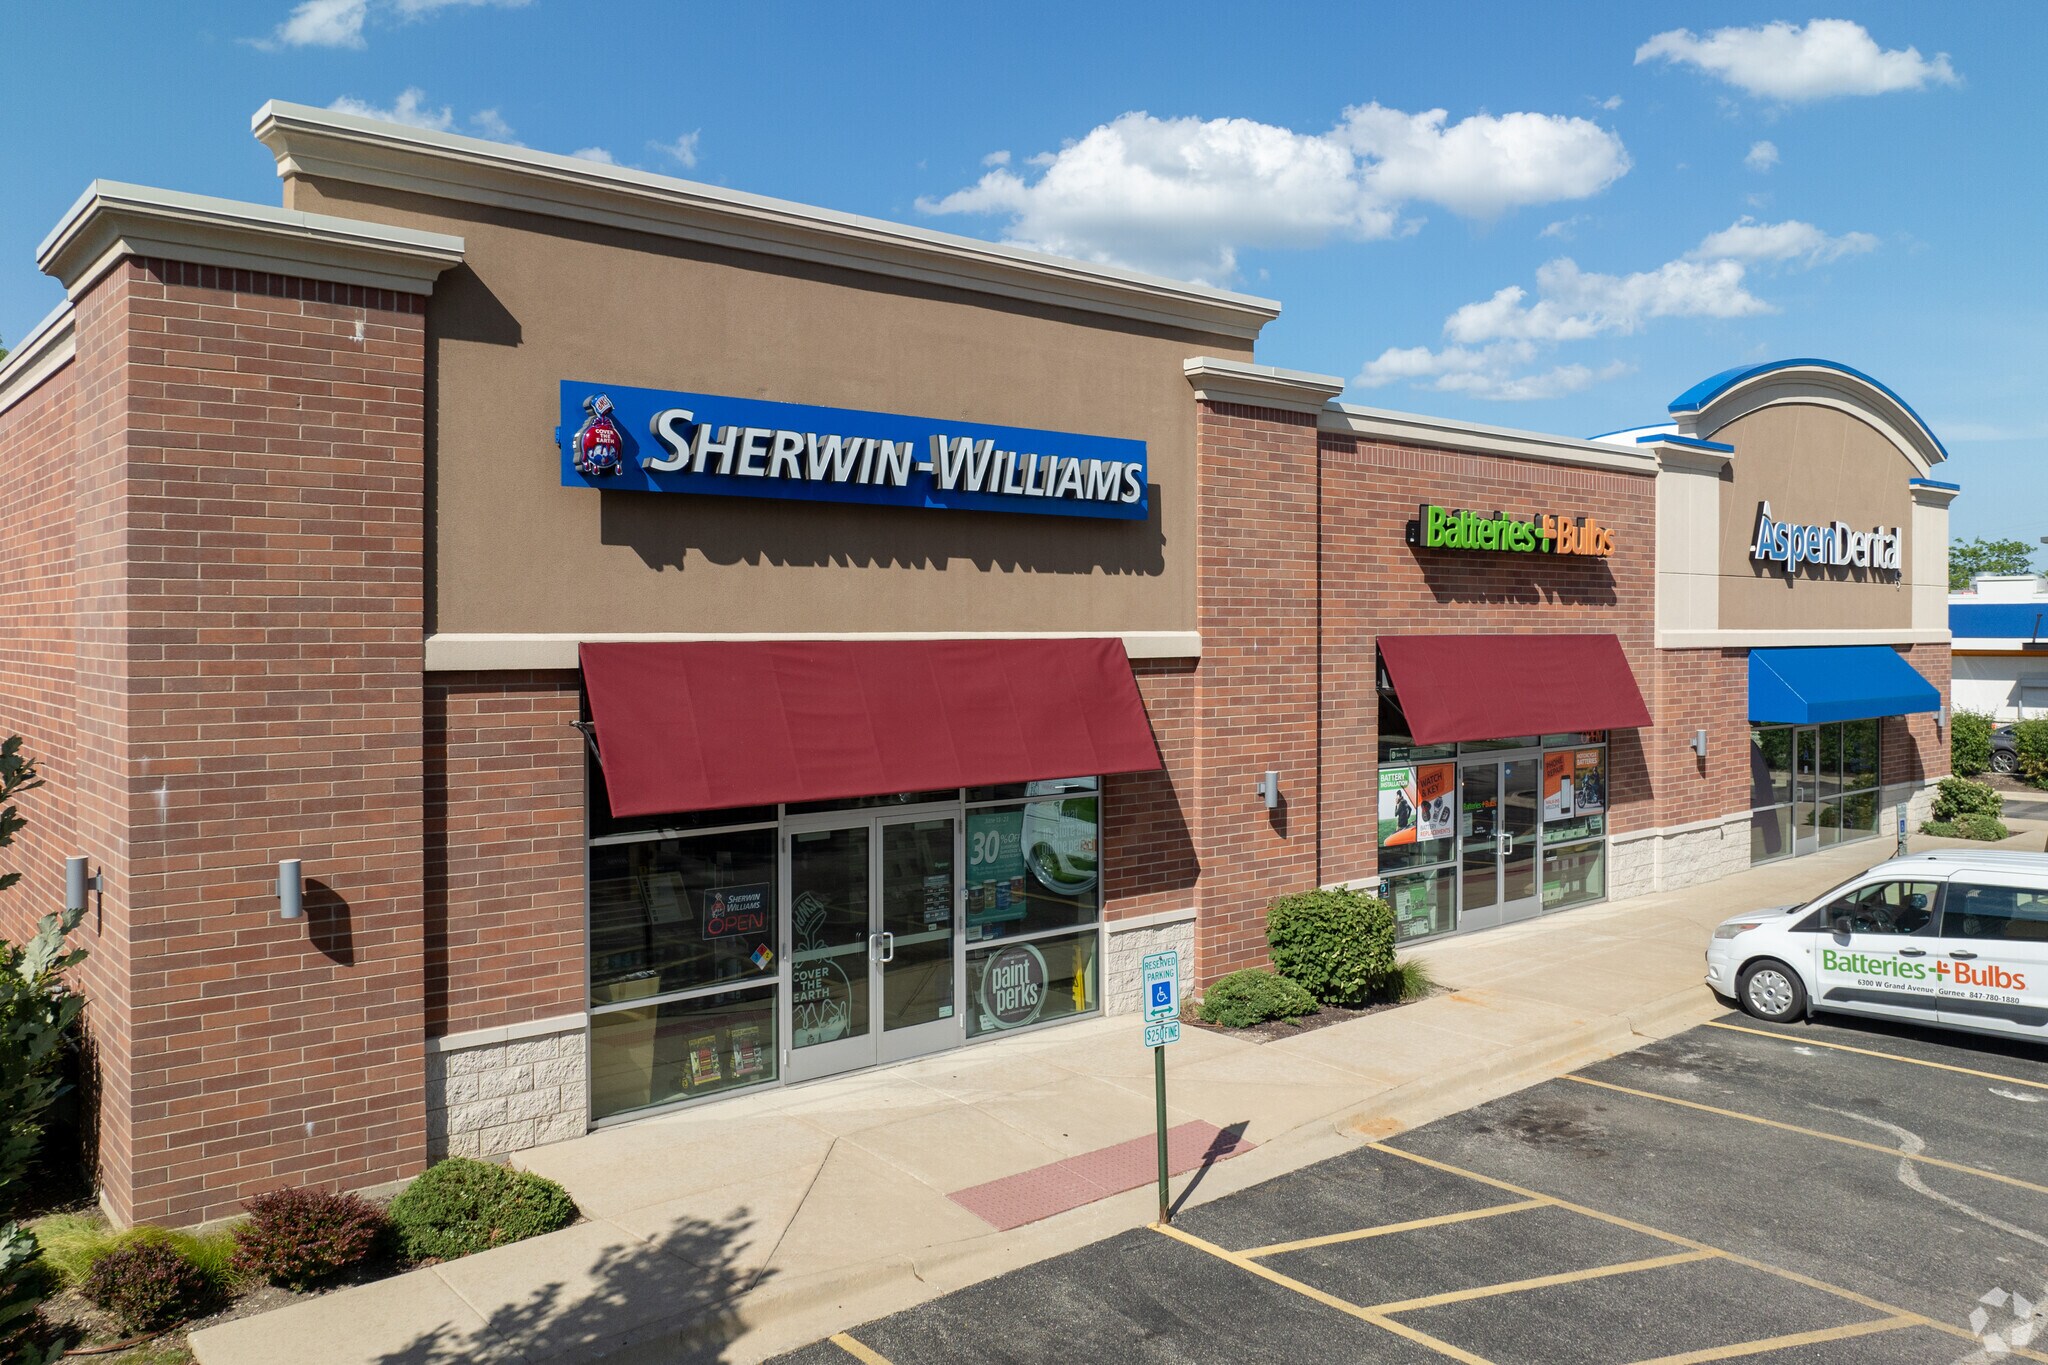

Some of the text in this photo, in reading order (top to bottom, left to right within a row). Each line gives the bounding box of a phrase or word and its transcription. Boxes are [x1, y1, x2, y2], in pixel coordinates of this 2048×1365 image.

[646, 408, 1143, 503] SHERWIN-WILLIAMS
[1426, 505, 1536, 552] Batteries
[1557, 516, 1616, 557] Bulbs
[1577, 758, 1598, 766] BATTERIES
[1380, 773, 1406, 781] BATTERY
[1421, 772, 1443, 788] WATCH
[1422, 784, 1440, 798] & KEY
[970, 830, 1000, 866] 30
[728, 893, 760, 904] SHERWIN
[727, 902, 760, 912] WILLIAMS
[708, 912, 764, 934] OPEN
[1145, 957, 1176, 970] RESERVED
[1823, 949, 1926, 979] Batteries
[1954, 962, 2026, 990] Bulbs
[792, 967, 829, 982] COVER
[992, 959, 1030, 994] paint
[1147, 968, 1174, 981] PARKING
[801, 978, 822, 991] THE
[1857, 979, 1874, 987] 6300
[1884, 981, 1906, 990] Grand
[1907, 984, 1935, 993] Avenue
[1938, 988, 1966, 997] Gurnee
[793, 987, 830, 1003] EARTH
[997, 981, 1038, 1016] perks
[1147, 1024, 1178, 1042] $250 FINE
